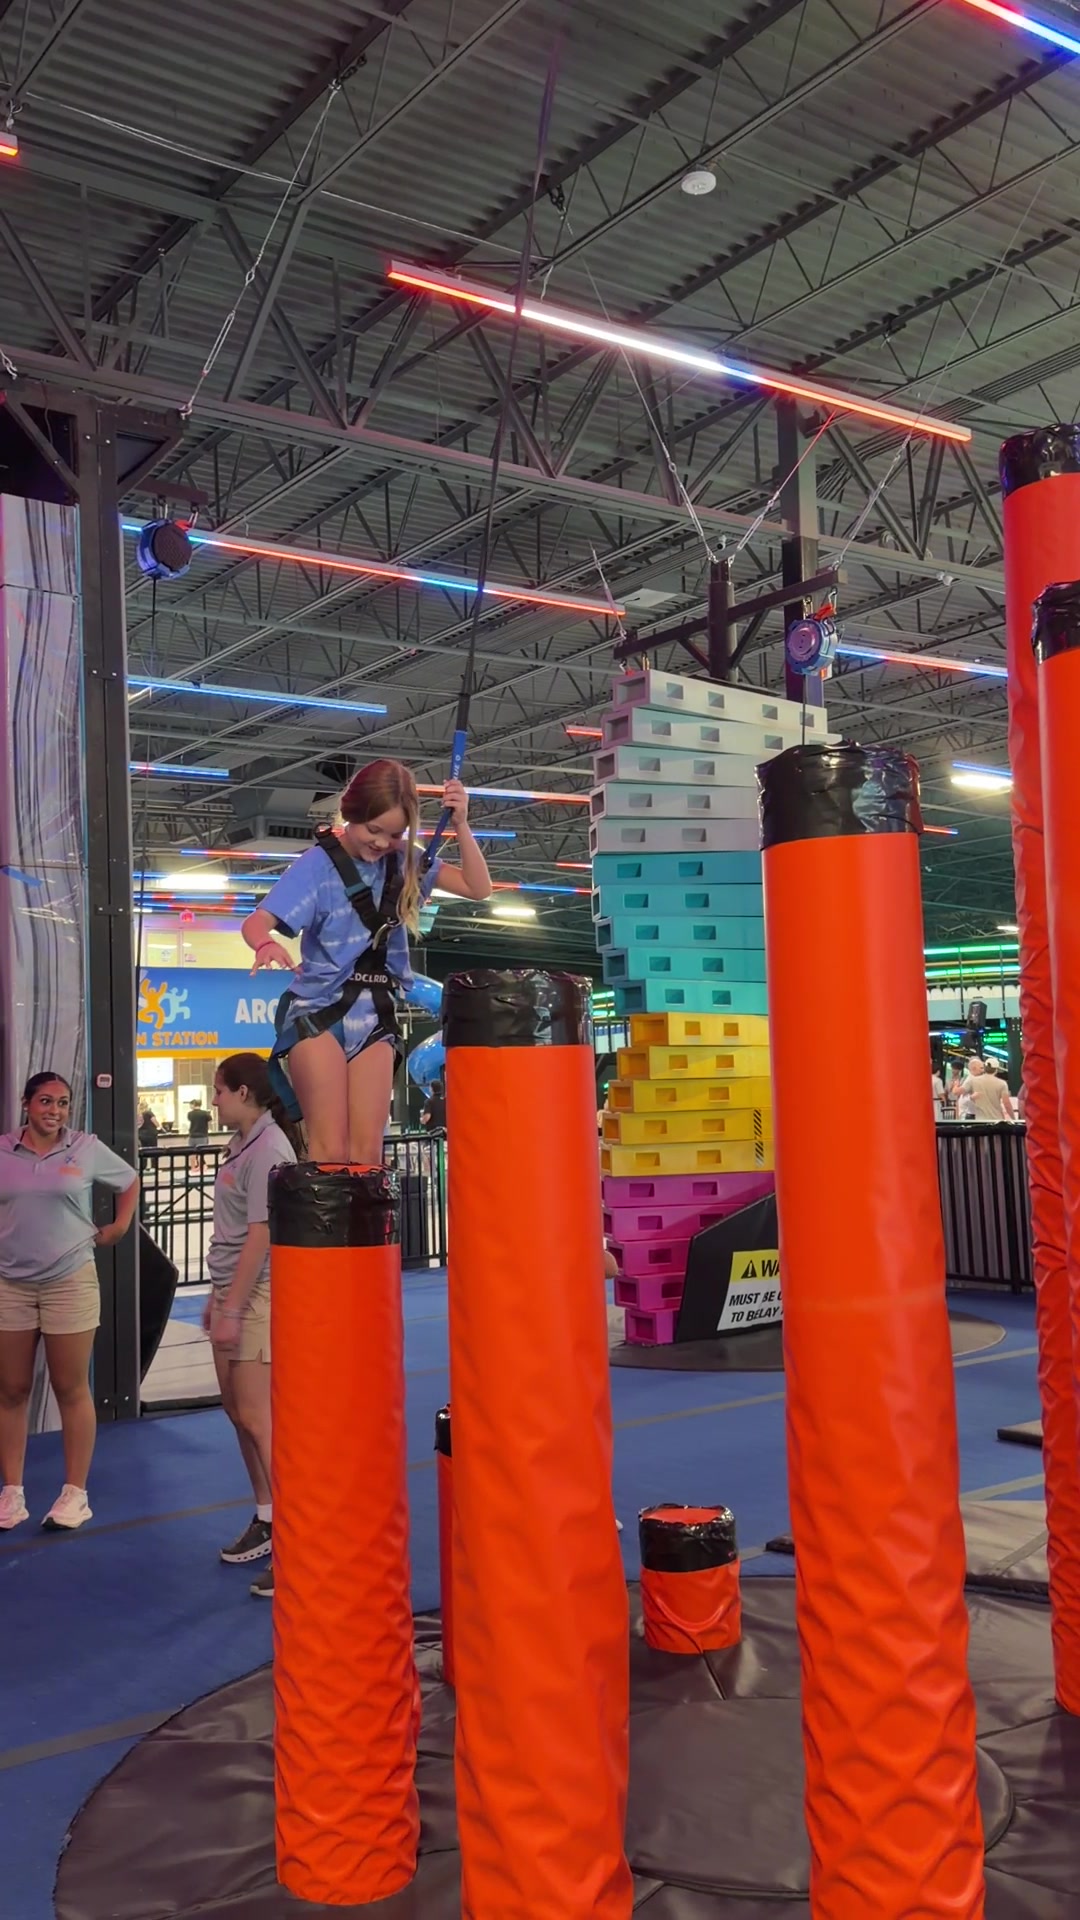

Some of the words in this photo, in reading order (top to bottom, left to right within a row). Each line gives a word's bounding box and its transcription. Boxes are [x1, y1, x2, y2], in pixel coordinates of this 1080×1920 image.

[152, 1031, 219, 1047] STATION
[729, 1292, 760, 1307] MUST
[762, 1290, 776, 1303] BE
[731, 1311, 744, 1323] TO
[746, 1306, 780, 1321] BELAY
